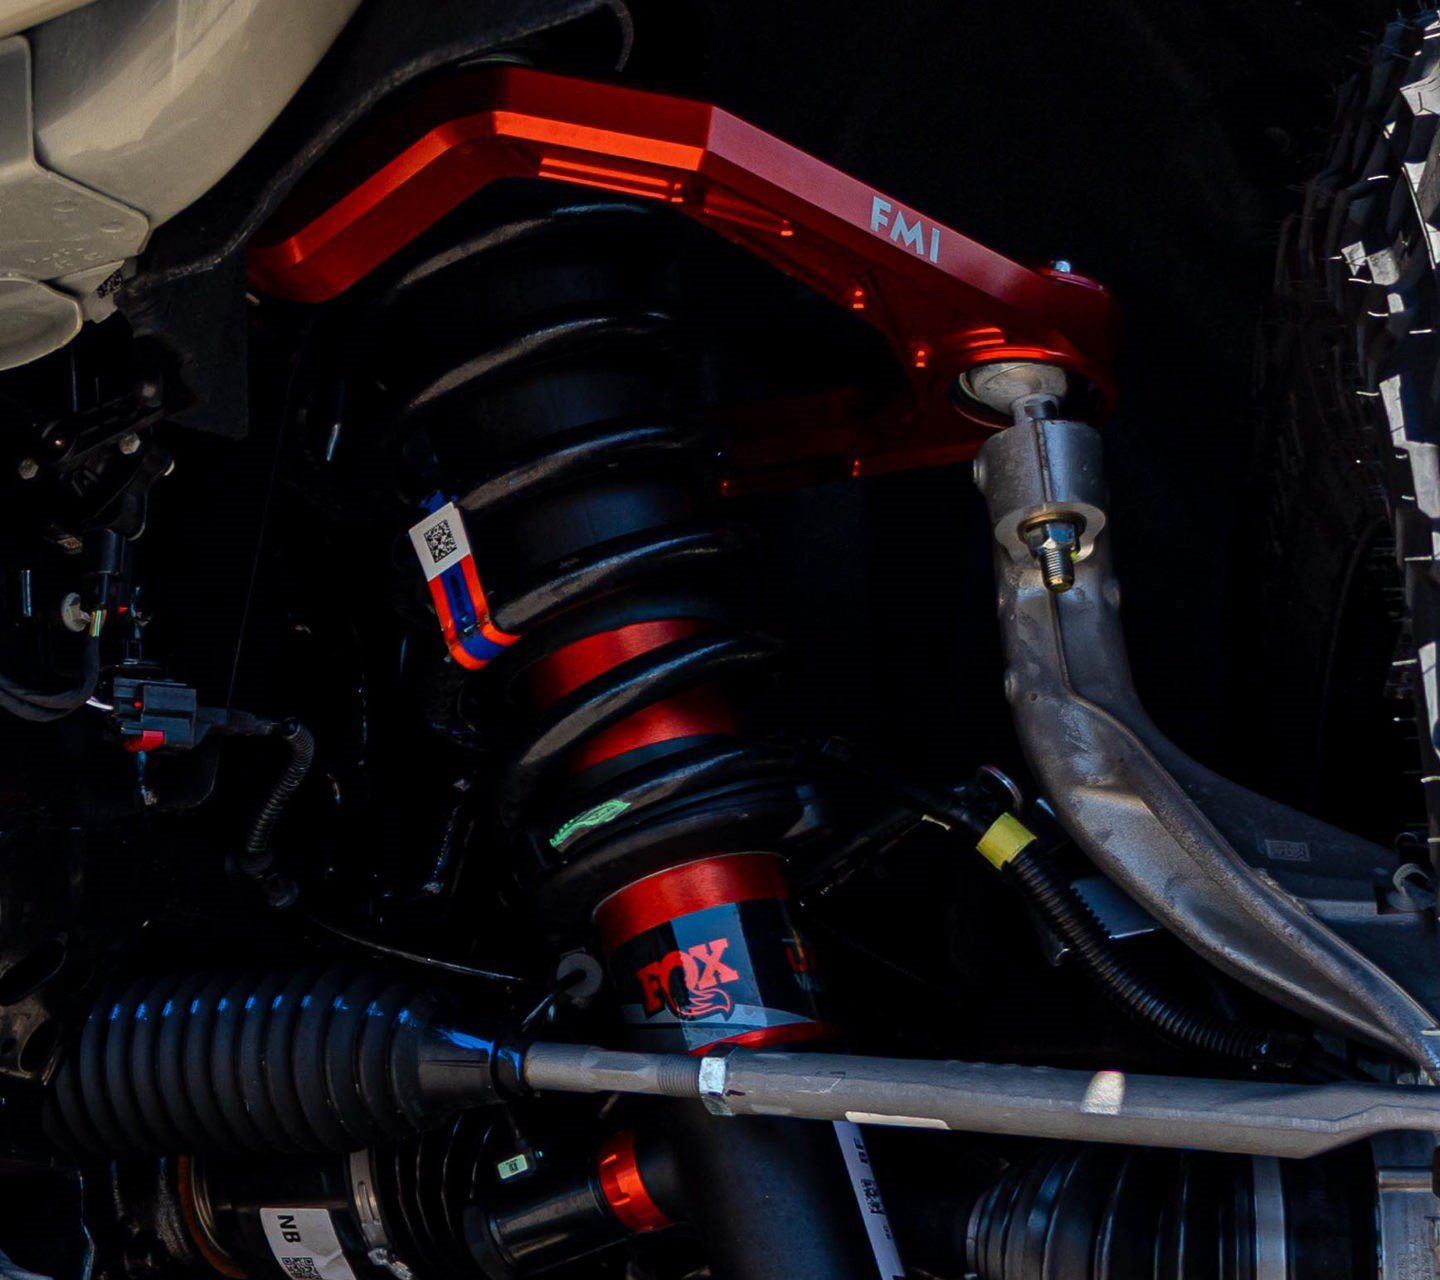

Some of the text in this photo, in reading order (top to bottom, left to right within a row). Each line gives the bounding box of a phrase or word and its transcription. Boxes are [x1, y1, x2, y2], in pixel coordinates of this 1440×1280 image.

[871, 195, 940, 263] FMI
[635, 937, 740, 1016] FOX
[277, 1214, 302, 1243] NB
